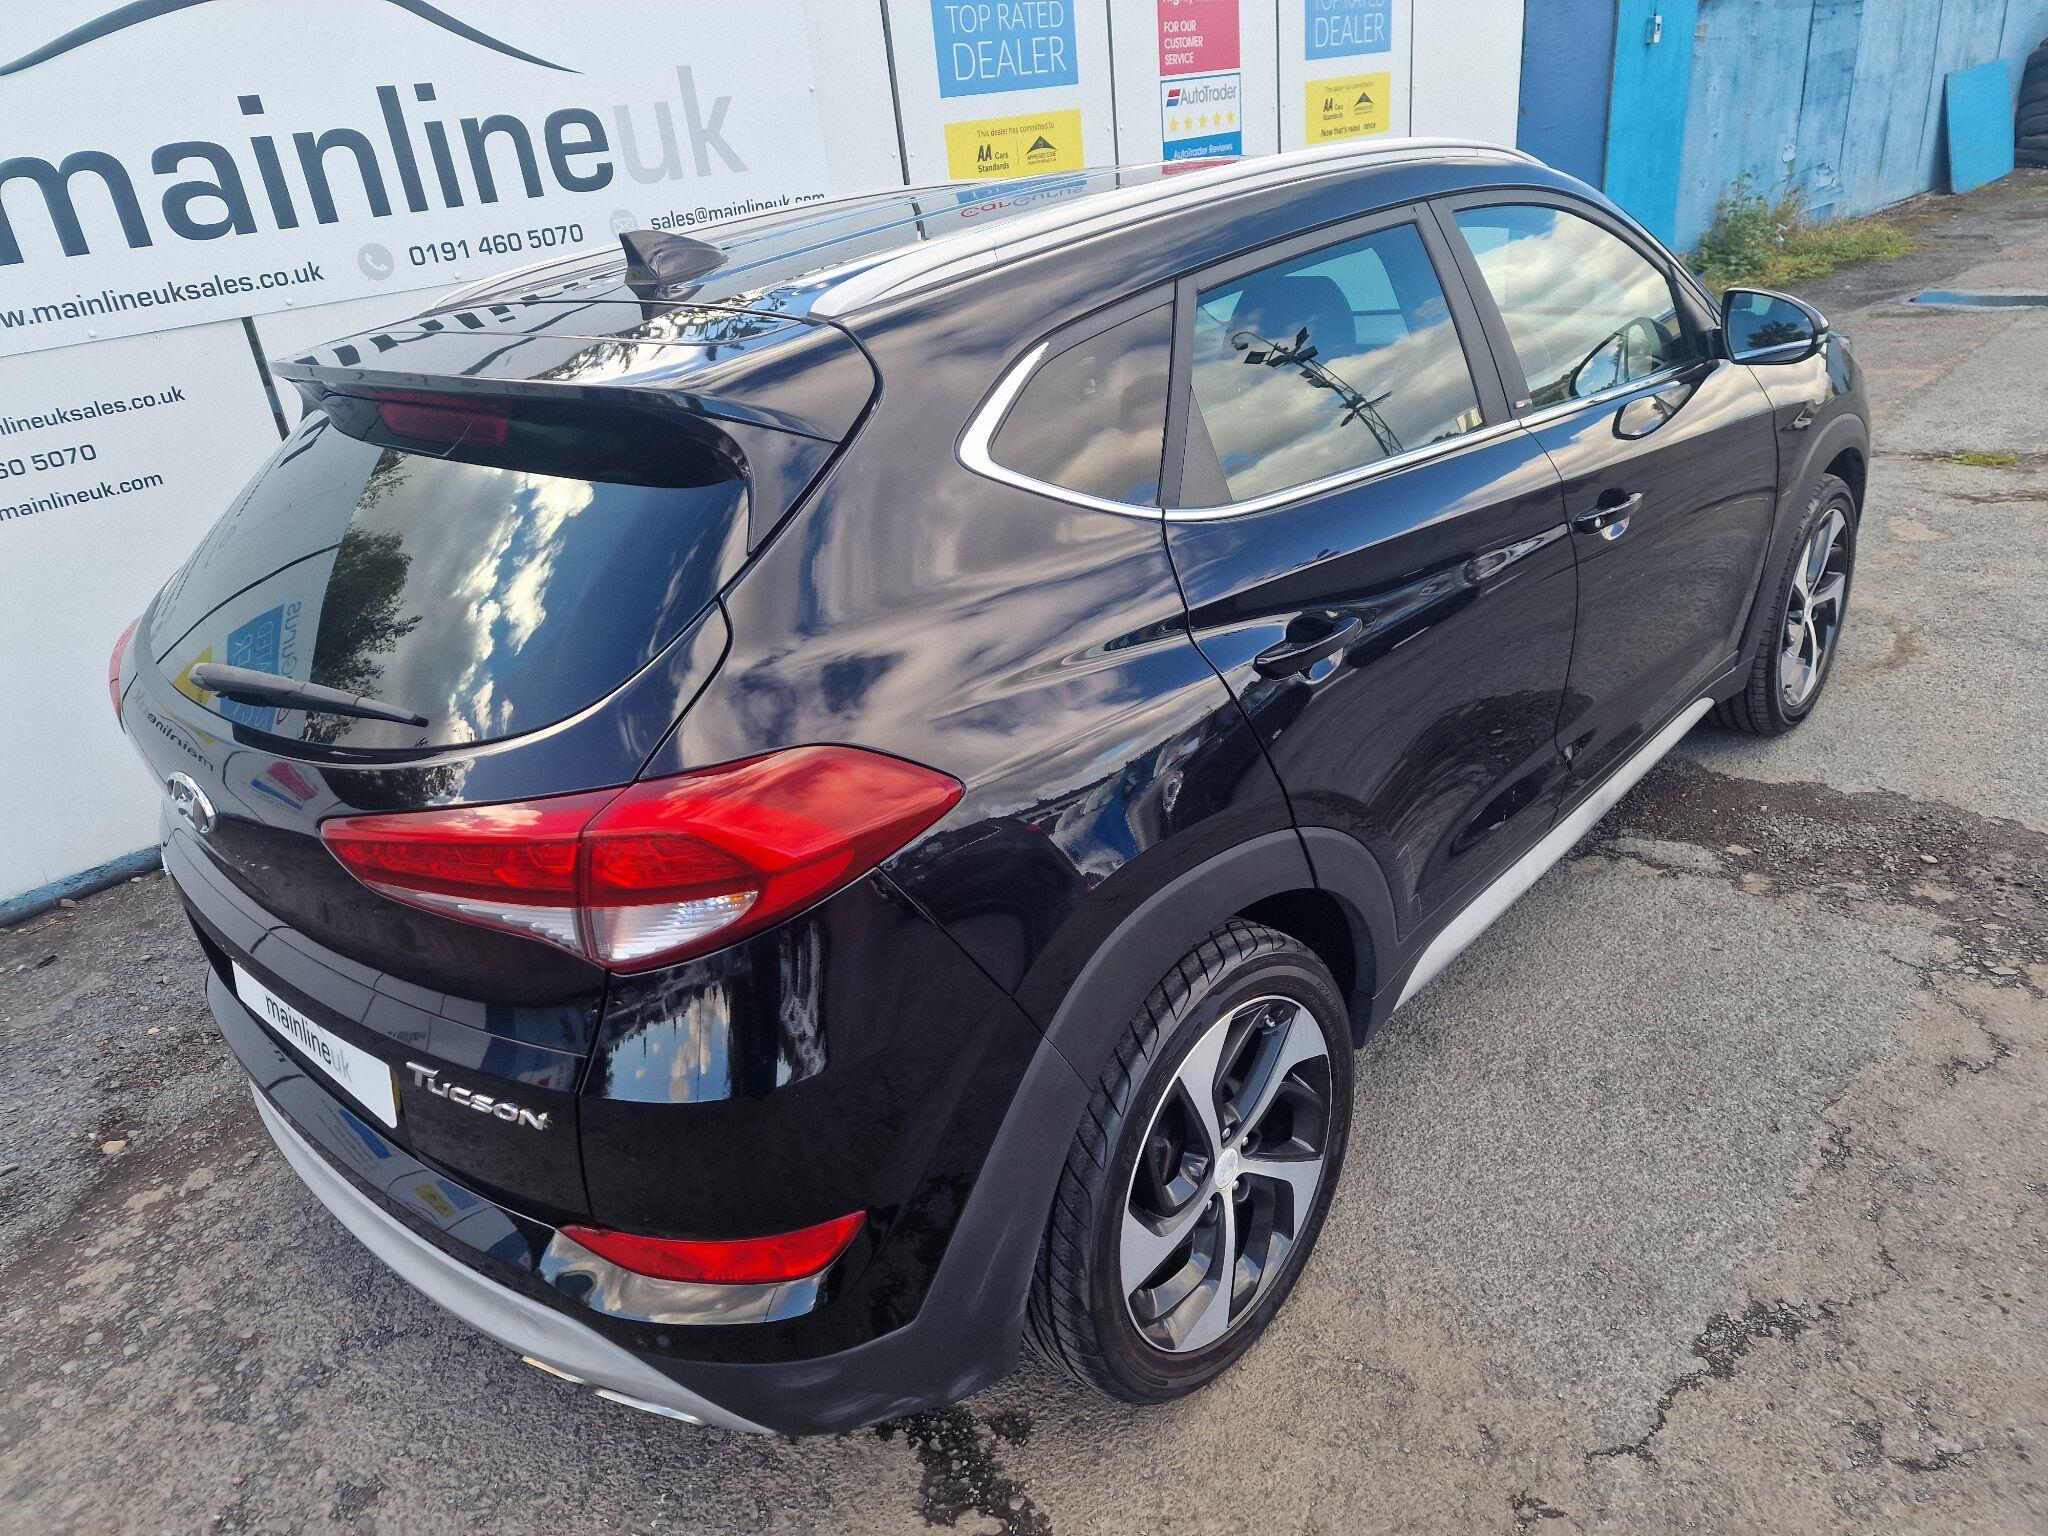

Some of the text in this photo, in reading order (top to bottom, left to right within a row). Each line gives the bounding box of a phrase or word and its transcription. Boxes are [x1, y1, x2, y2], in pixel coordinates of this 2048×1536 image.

[944, 1, 1064, 34] TOP RATED
[1163, 20, 1197, 33] FOR OUR
[1315, 12, 1385, 48] DEALER
[952, 36, 1067, 81] DEALER
[1164, 35, 1204, 49] CUSTOMER
[1164, 52, 1194, 65] SERVICE
[1180, 84, 1238, 106] AutoTrader
[977, 144, 1009, 162] AA Cars
[977, 161, 1010, 173] Standards
[650, 193, 825, 231] sales@mainlineuk
[409, 223, 585, 267] 0191 460 5070
[0, 262, 325, 328] w.mainlineuksales.co.uk
[31, 444, 97, 472] 5070
[0, 473, 164, 521] mainlineuk.com
[264, 994, 353, 1084] mainlineuk
[405, 1060, 551, 1131] TUCSON
